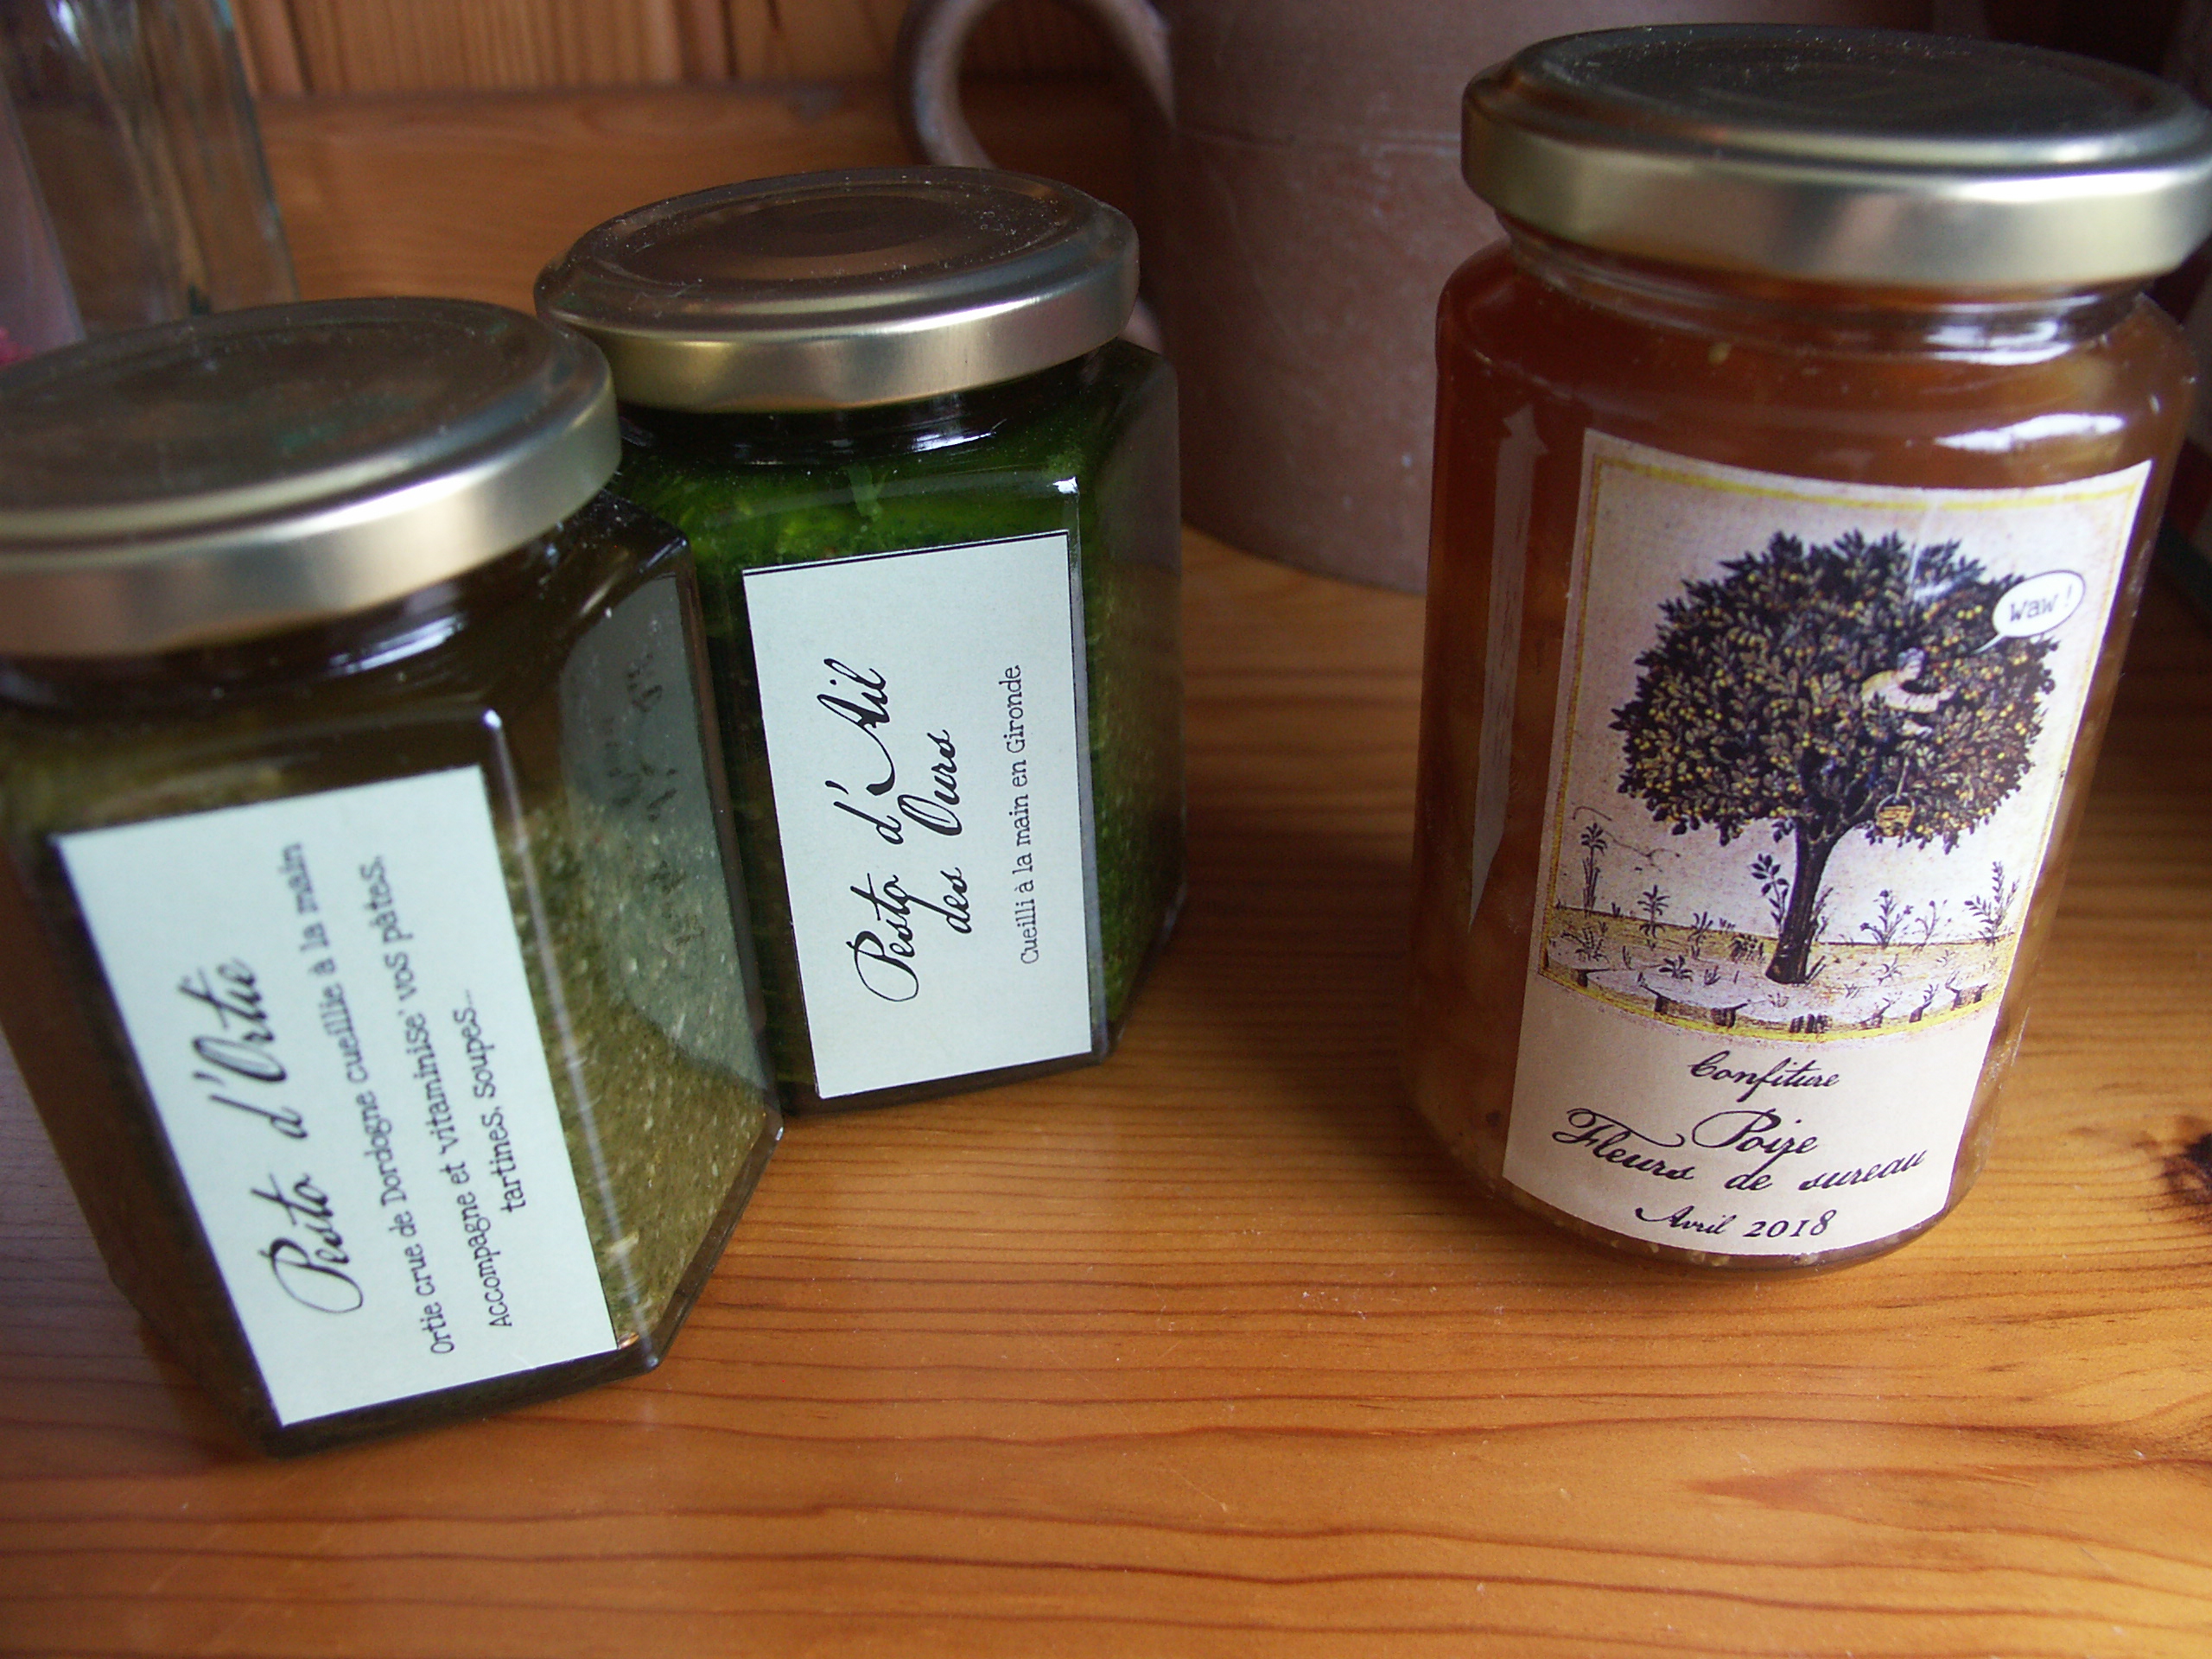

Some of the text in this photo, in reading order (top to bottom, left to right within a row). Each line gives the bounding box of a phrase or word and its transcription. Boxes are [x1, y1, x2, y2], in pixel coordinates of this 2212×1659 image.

[898, 729, 972, 933] des Ours
[998, 664, 1039, 965] Cueilli à la main en Gironde
[383, 951, 416, 1002] vos
[846, 873, 918, 1001] Pesto
[277, 842, 454, 1355] Ortie crue de Dordogne cueillie à la main
[1688, 1050, 1840, 1103] Confiture
[178, 957, 364, 1314] Pesto d'Ortie
[439, 1161, 470, 1185] et
[1552, 1107, 1929, 1192] Fleurs de sureau
[1691, 1108, 1819, 1155] Poire
[456, 1191, 513, 1328] Accompagne
[1635, 1206, 1839, 1238] Avril 2018
